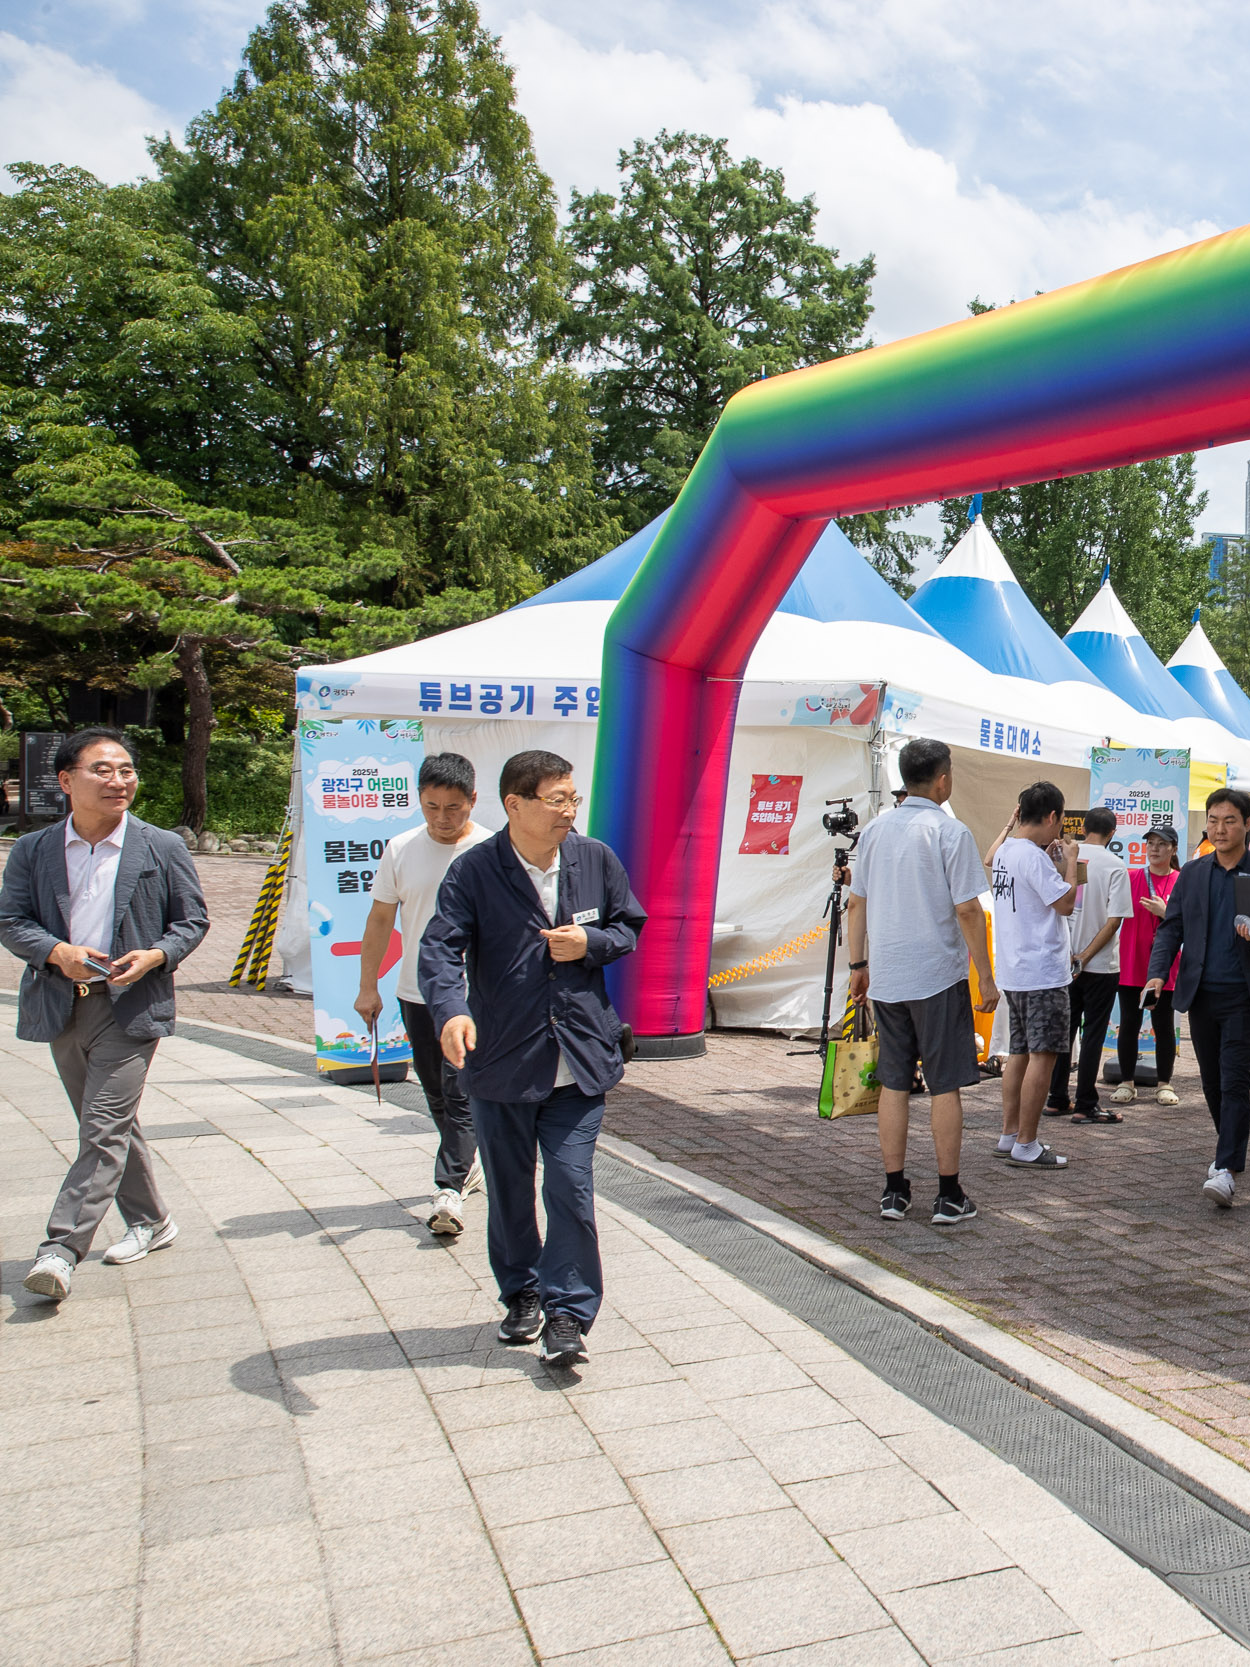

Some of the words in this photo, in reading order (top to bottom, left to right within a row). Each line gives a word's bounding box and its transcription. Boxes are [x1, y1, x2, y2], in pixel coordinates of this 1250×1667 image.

[419, 682, 534, 715] 튜브공기
[980, 718, 1040, 755] 물품대여소
[352, 768, 378, 776] 2025년
[322, 778, 363, 793] 광진구
[367, 777, 408, 792] 어린이
[322, 794, 379, 809] 물놀이장
[382, 793, 409, 808] 운영
[1128, 790, 1150, 798] 2025년
[757, 801, 774, 811] 튜브
[774, 801, 791, 811] 공기
[1104, 798, 1137, 812] 광진구
[1140, 799, 1174, 812] 어린이
[751, 812, 783, 823] 주입하는
[1115, 813, 1148, 826] 놀이장
[1151, 813, 1173, 827] 운영
